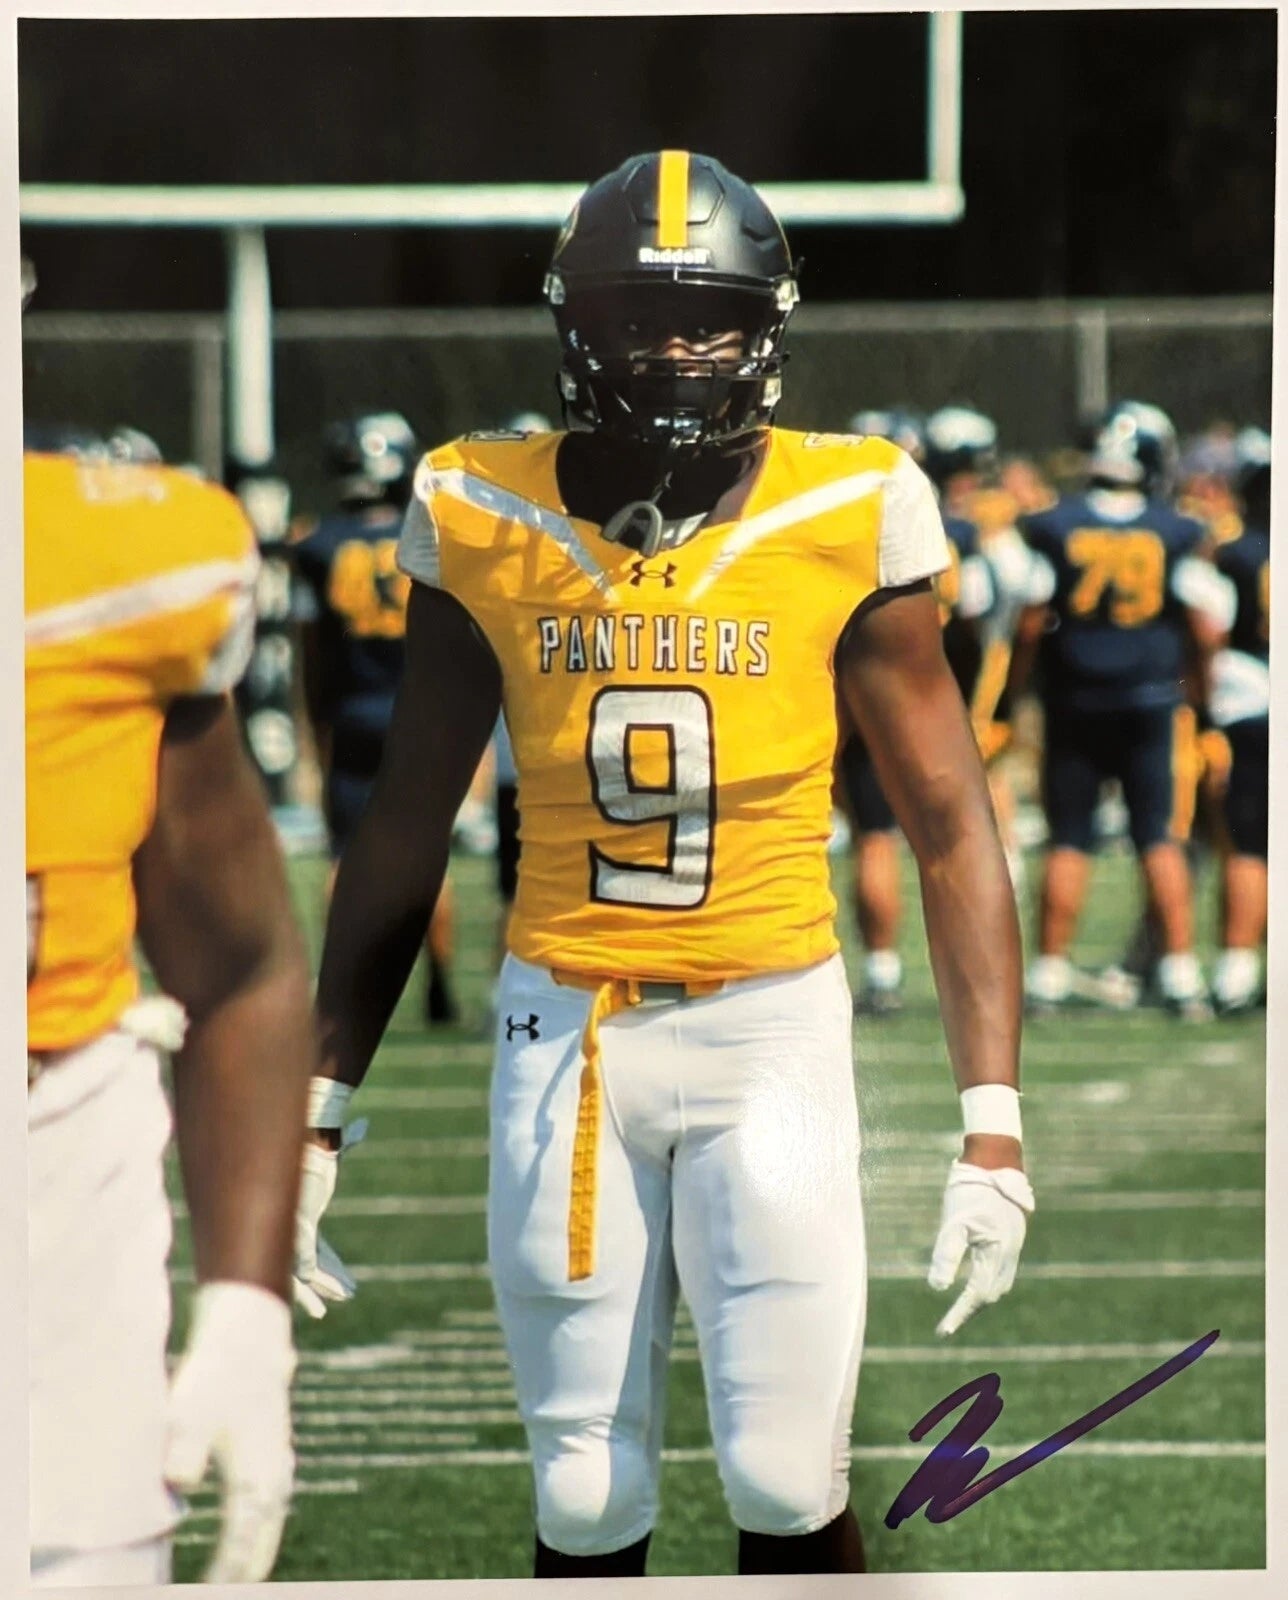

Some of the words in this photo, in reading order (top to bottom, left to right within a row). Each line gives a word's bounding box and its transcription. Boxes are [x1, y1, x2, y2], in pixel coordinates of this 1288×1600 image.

[1065, 527, 1166, 629] 79
[537, 614, 770, 676] PANTHERS
[586, 684, 717, 912] 9
